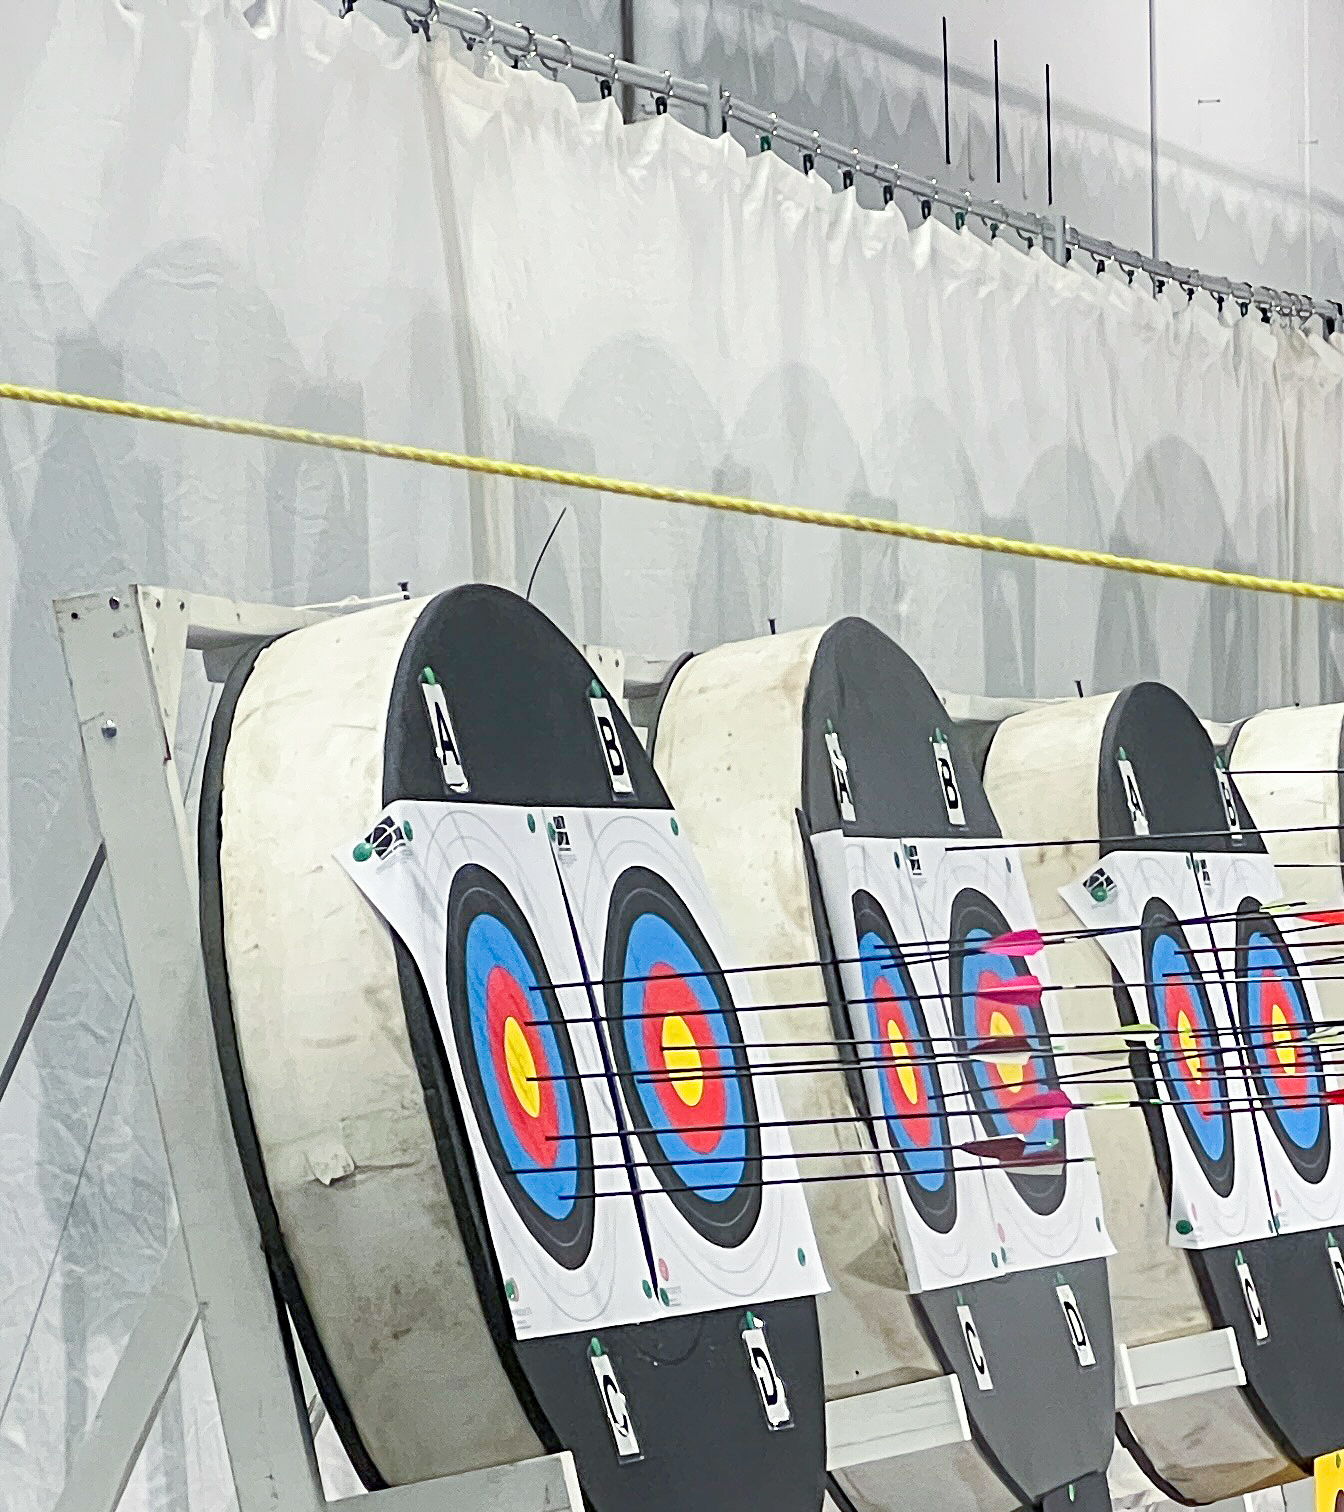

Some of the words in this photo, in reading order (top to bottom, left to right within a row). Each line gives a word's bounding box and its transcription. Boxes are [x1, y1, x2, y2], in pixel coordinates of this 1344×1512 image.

[434, 701, 462, 766] A
[597, 716, 625, 776] B
[937, 757, 960, 810] B
[1126, 775, 1146, 822] A
[1063, 1300, 1087, 1347] D
[1244, 1278, 1262, 1326] C
[964, 1321, 986, 1375] C
[602, 1374, 630, 1437] C
